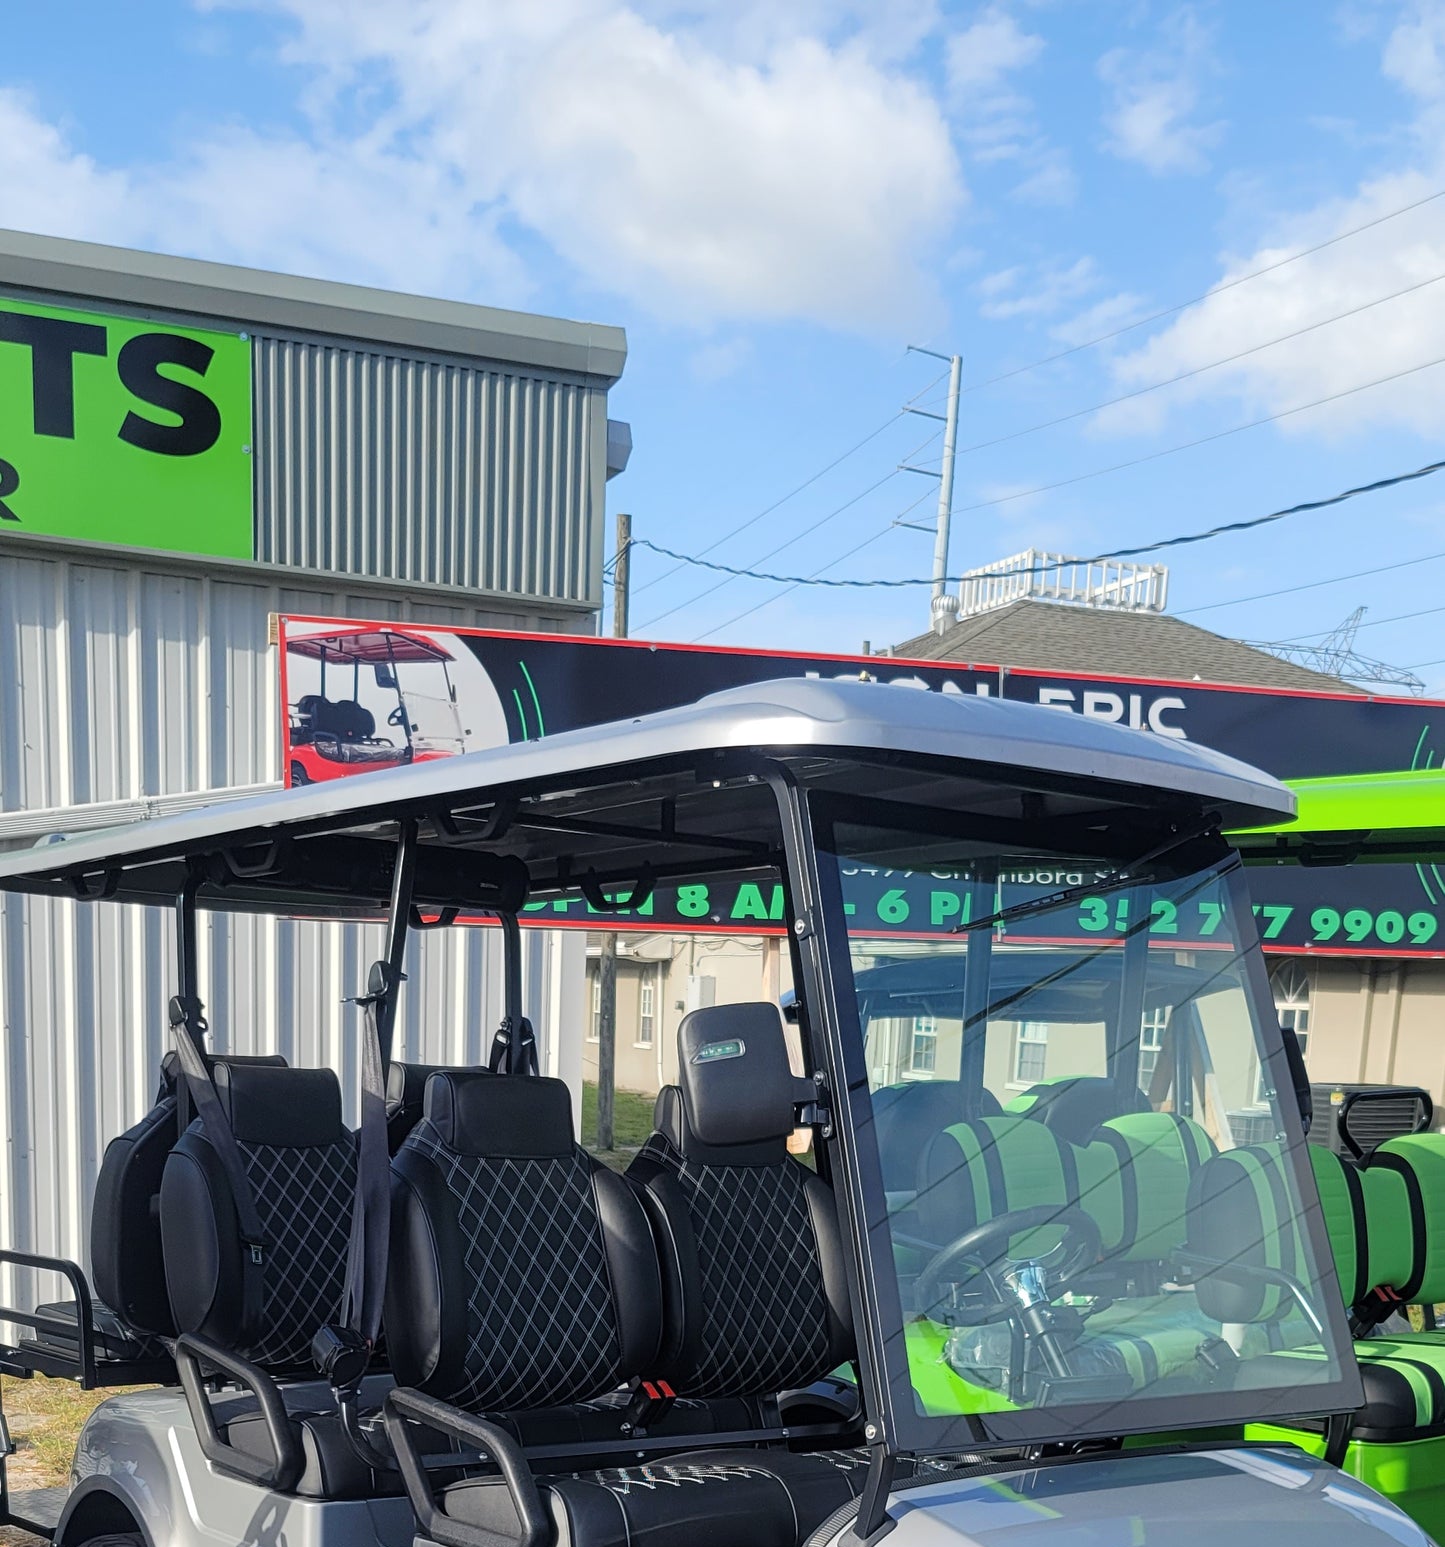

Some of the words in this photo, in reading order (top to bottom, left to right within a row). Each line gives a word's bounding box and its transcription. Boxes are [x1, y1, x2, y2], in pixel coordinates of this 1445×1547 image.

[676, 884, 710, 918] 8
[876, 889, 910, 924] 6
[1198, 902, 1294, 939] 77
[1310, 908, 1438, 944] 9909
